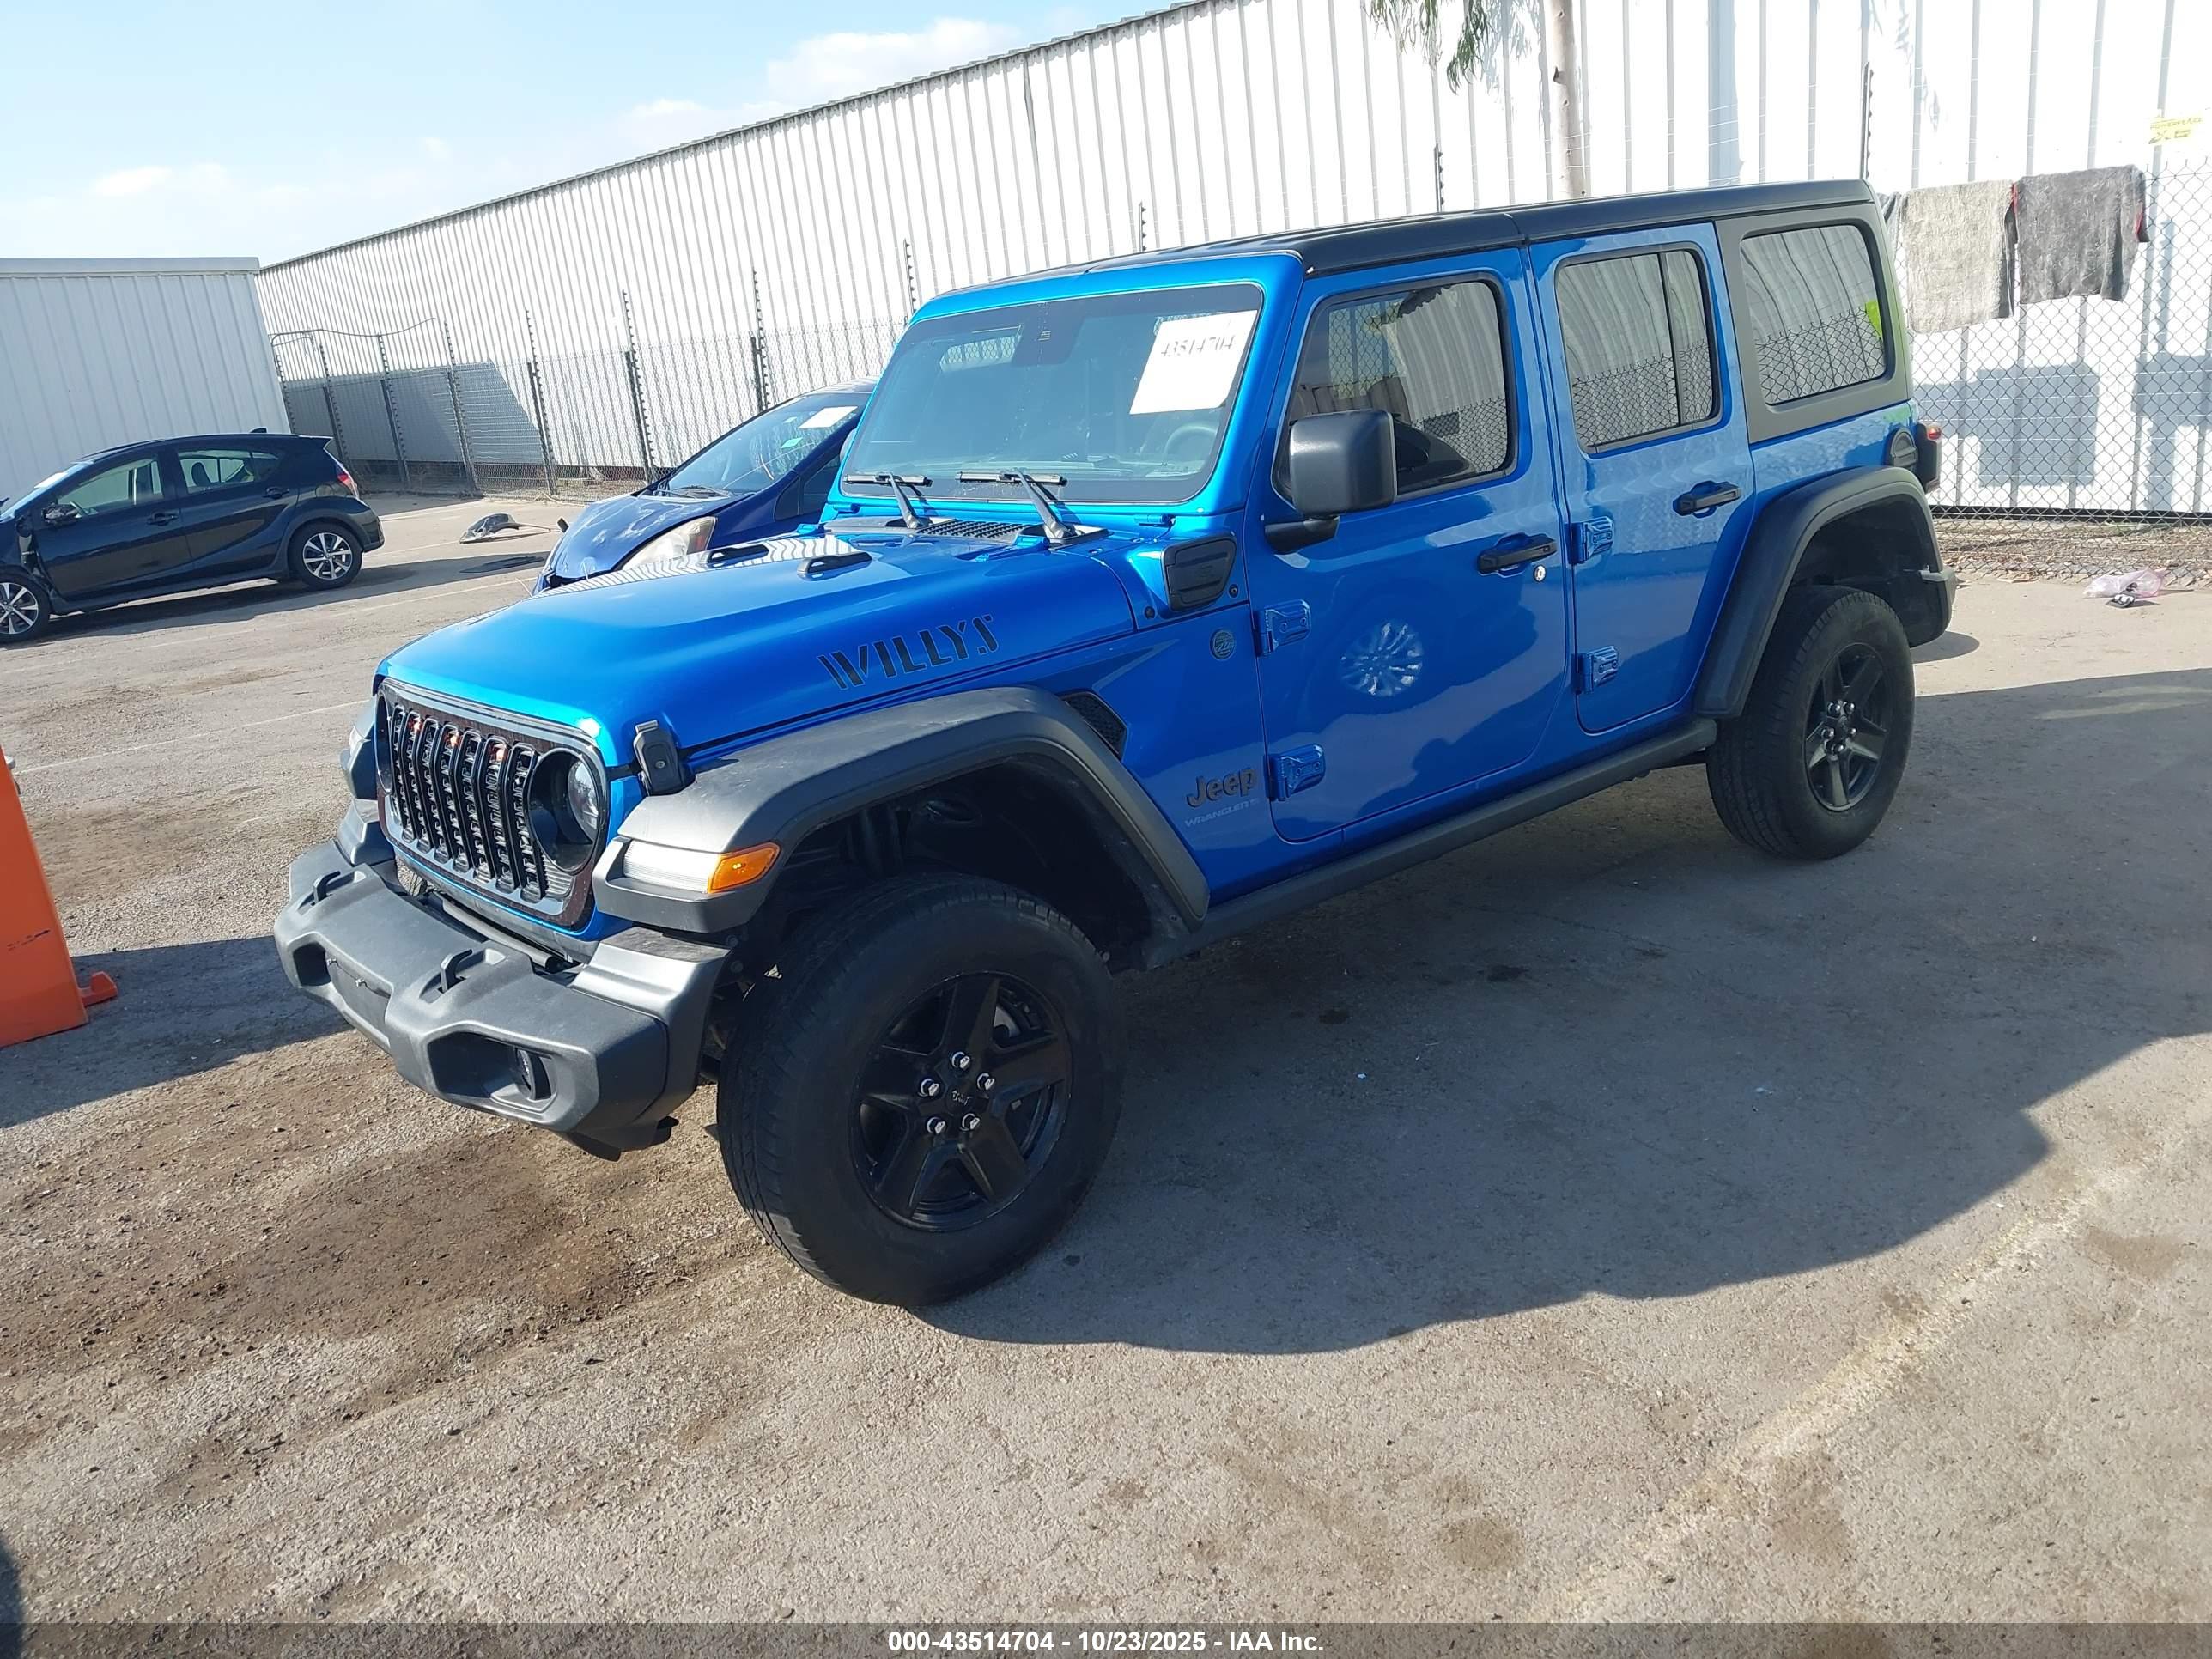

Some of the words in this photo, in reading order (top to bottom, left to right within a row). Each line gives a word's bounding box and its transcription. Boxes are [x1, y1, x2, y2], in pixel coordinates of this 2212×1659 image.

[1161, 335, 1235, 357] 43514704
[817, 614, 999, 690] WILLYS
[1186, 768, 1257, 808] Jeep
